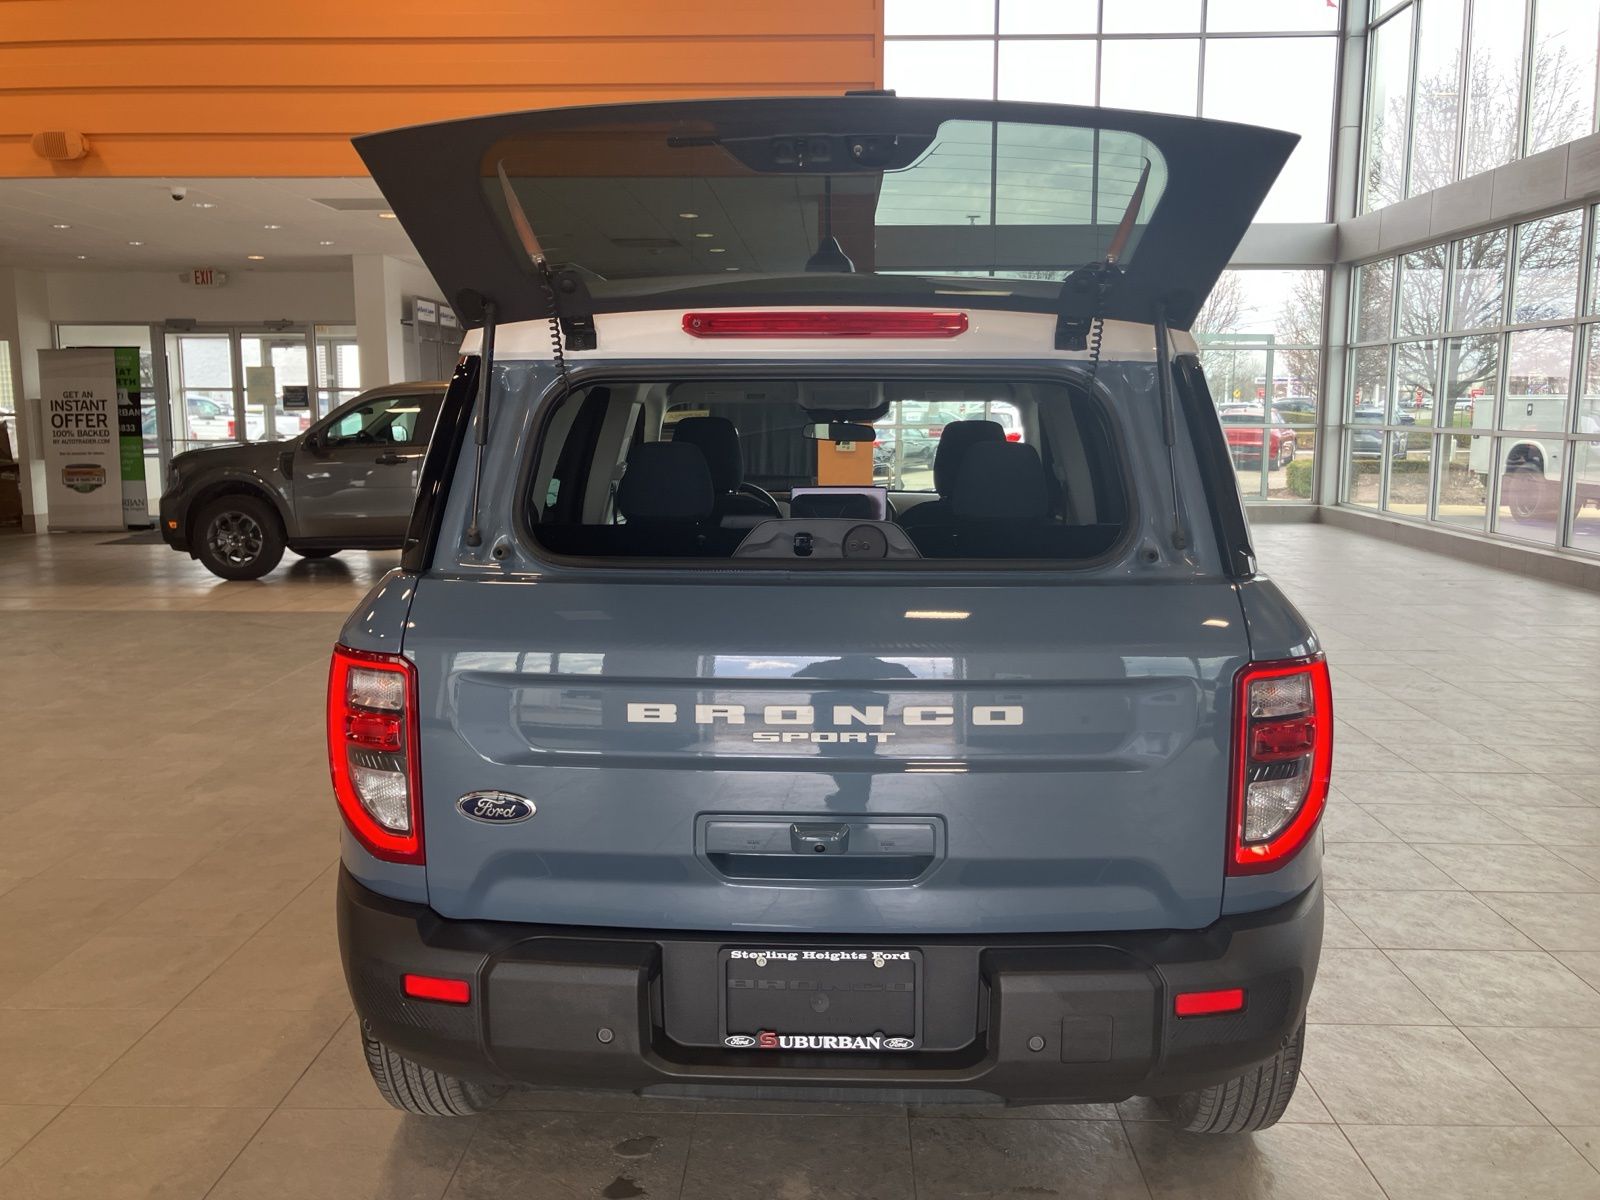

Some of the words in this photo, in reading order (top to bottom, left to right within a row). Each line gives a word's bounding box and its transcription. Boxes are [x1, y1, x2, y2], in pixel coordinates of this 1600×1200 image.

[194, 270, 213, 285] EXIT
[63, 391, 79, 399] GET
[82, 391, 93, 399] AN
[50, 399, 108, 412] INSTANT
[51, 413, 108, 429] OFFER
[52, 430, 75, 438] 100%
[77, 430, 110, 438] BACKED
[626, 702, 1024, 727] BRONCO
[752, 732, 897, 744] SPORT
[474, 798, 517, 818] Ford
[730, 951, 799, 961] Sterling
[802, 951, 868, 962] Heights
[872, 951, 911, 962] Ford
[759, 1032, 881, 1050] SUBURBAN
